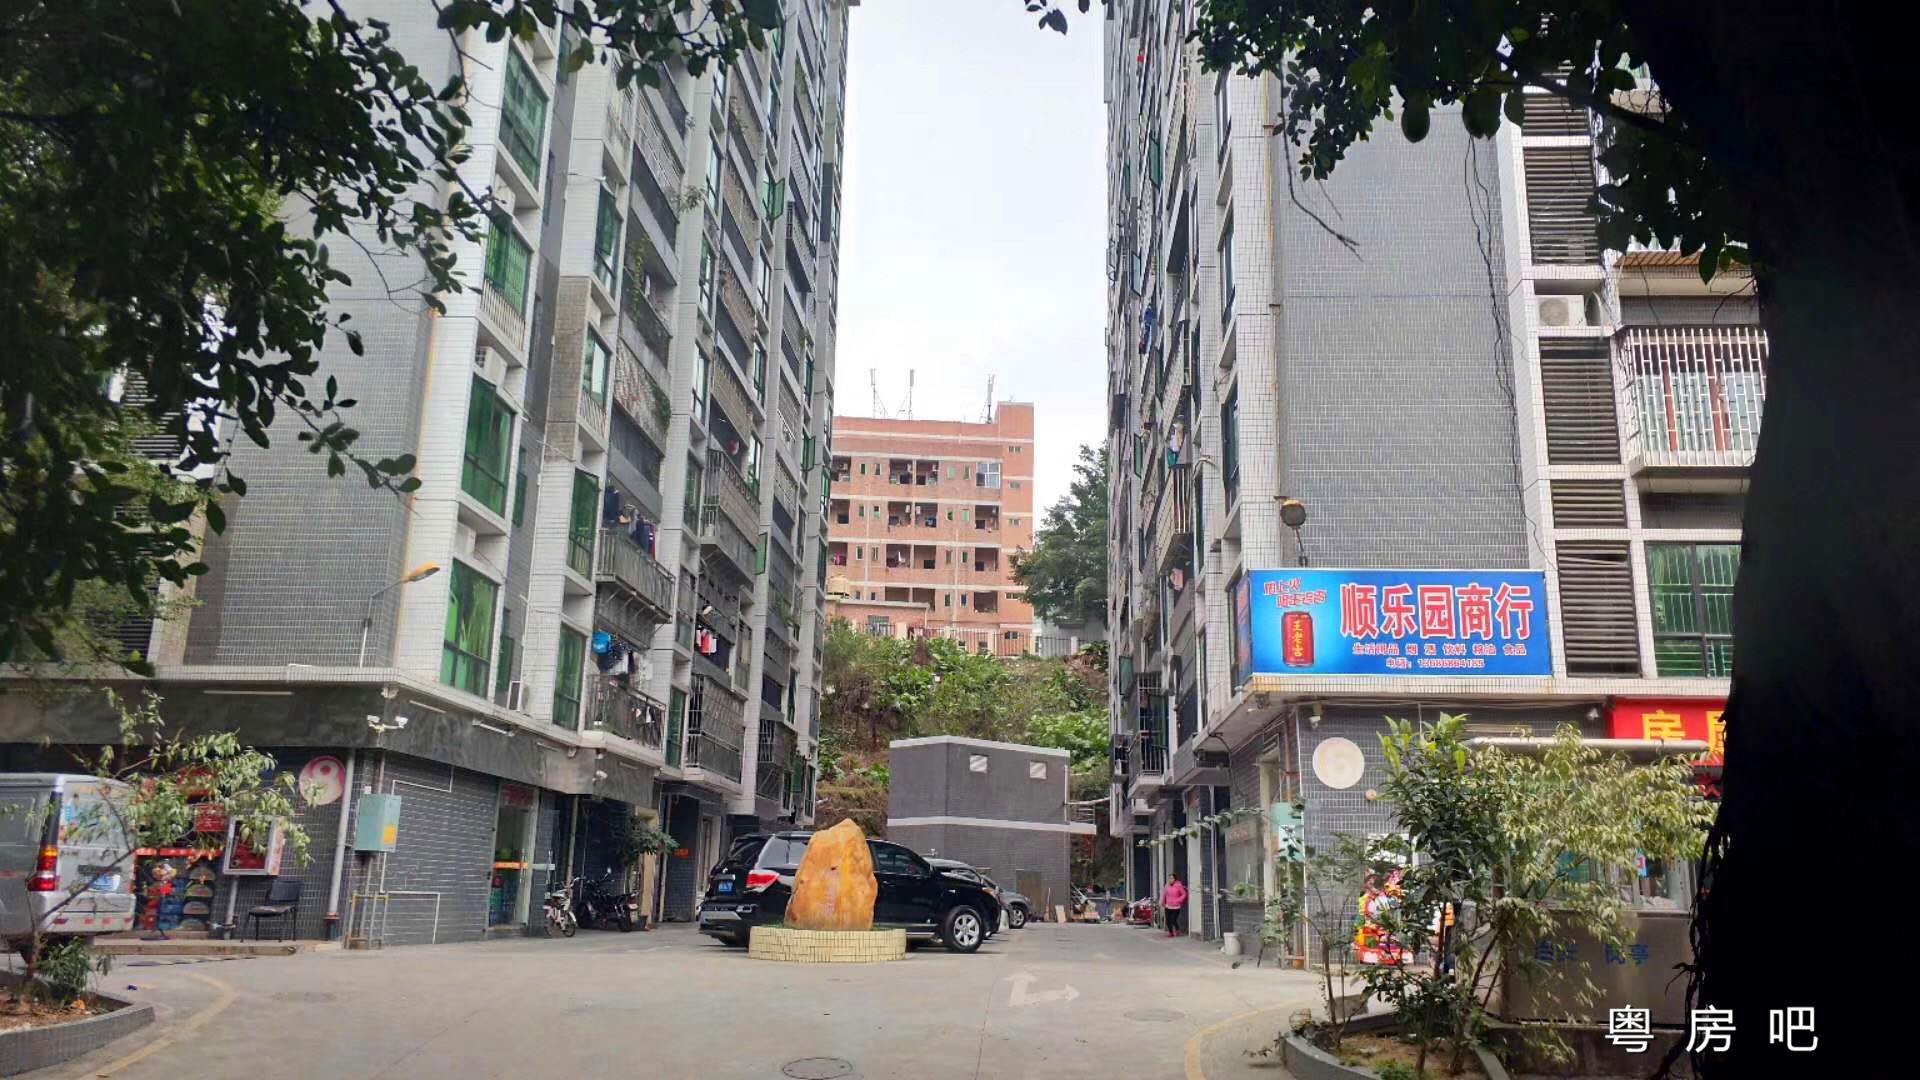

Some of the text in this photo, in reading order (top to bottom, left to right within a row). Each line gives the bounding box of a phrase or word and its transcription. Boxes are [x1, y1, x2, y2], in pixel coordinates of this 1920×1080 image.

[1340, 583, 1533, 639] 顺乐园商行
[1502, 643, 1527, 656] 食品
